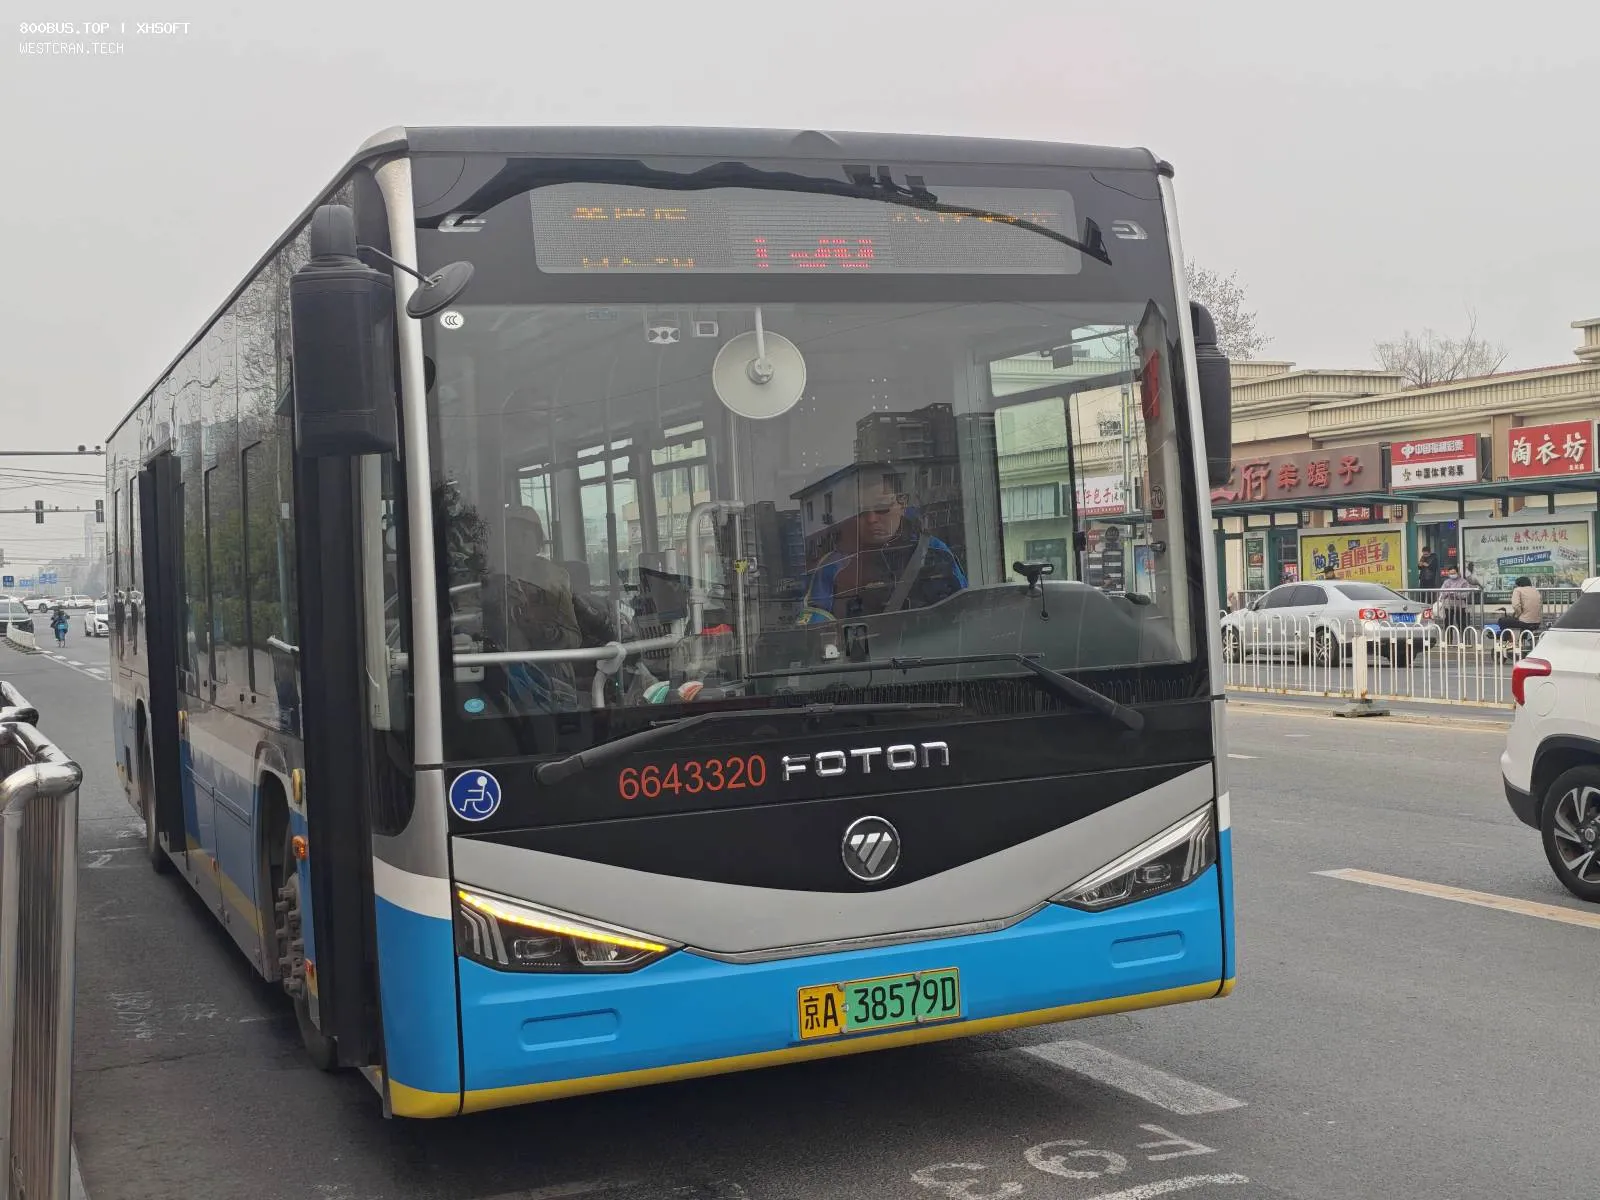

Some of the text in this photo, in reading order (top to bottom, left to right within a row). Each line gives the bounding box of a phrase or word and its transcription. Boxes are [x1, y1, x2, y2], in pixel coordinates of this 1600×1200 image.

[1415, 465, 1464, 479] 中国体育彩票
[619, 755, 766, 800] 6643320
[781, 741, 950, 781] FOTON
